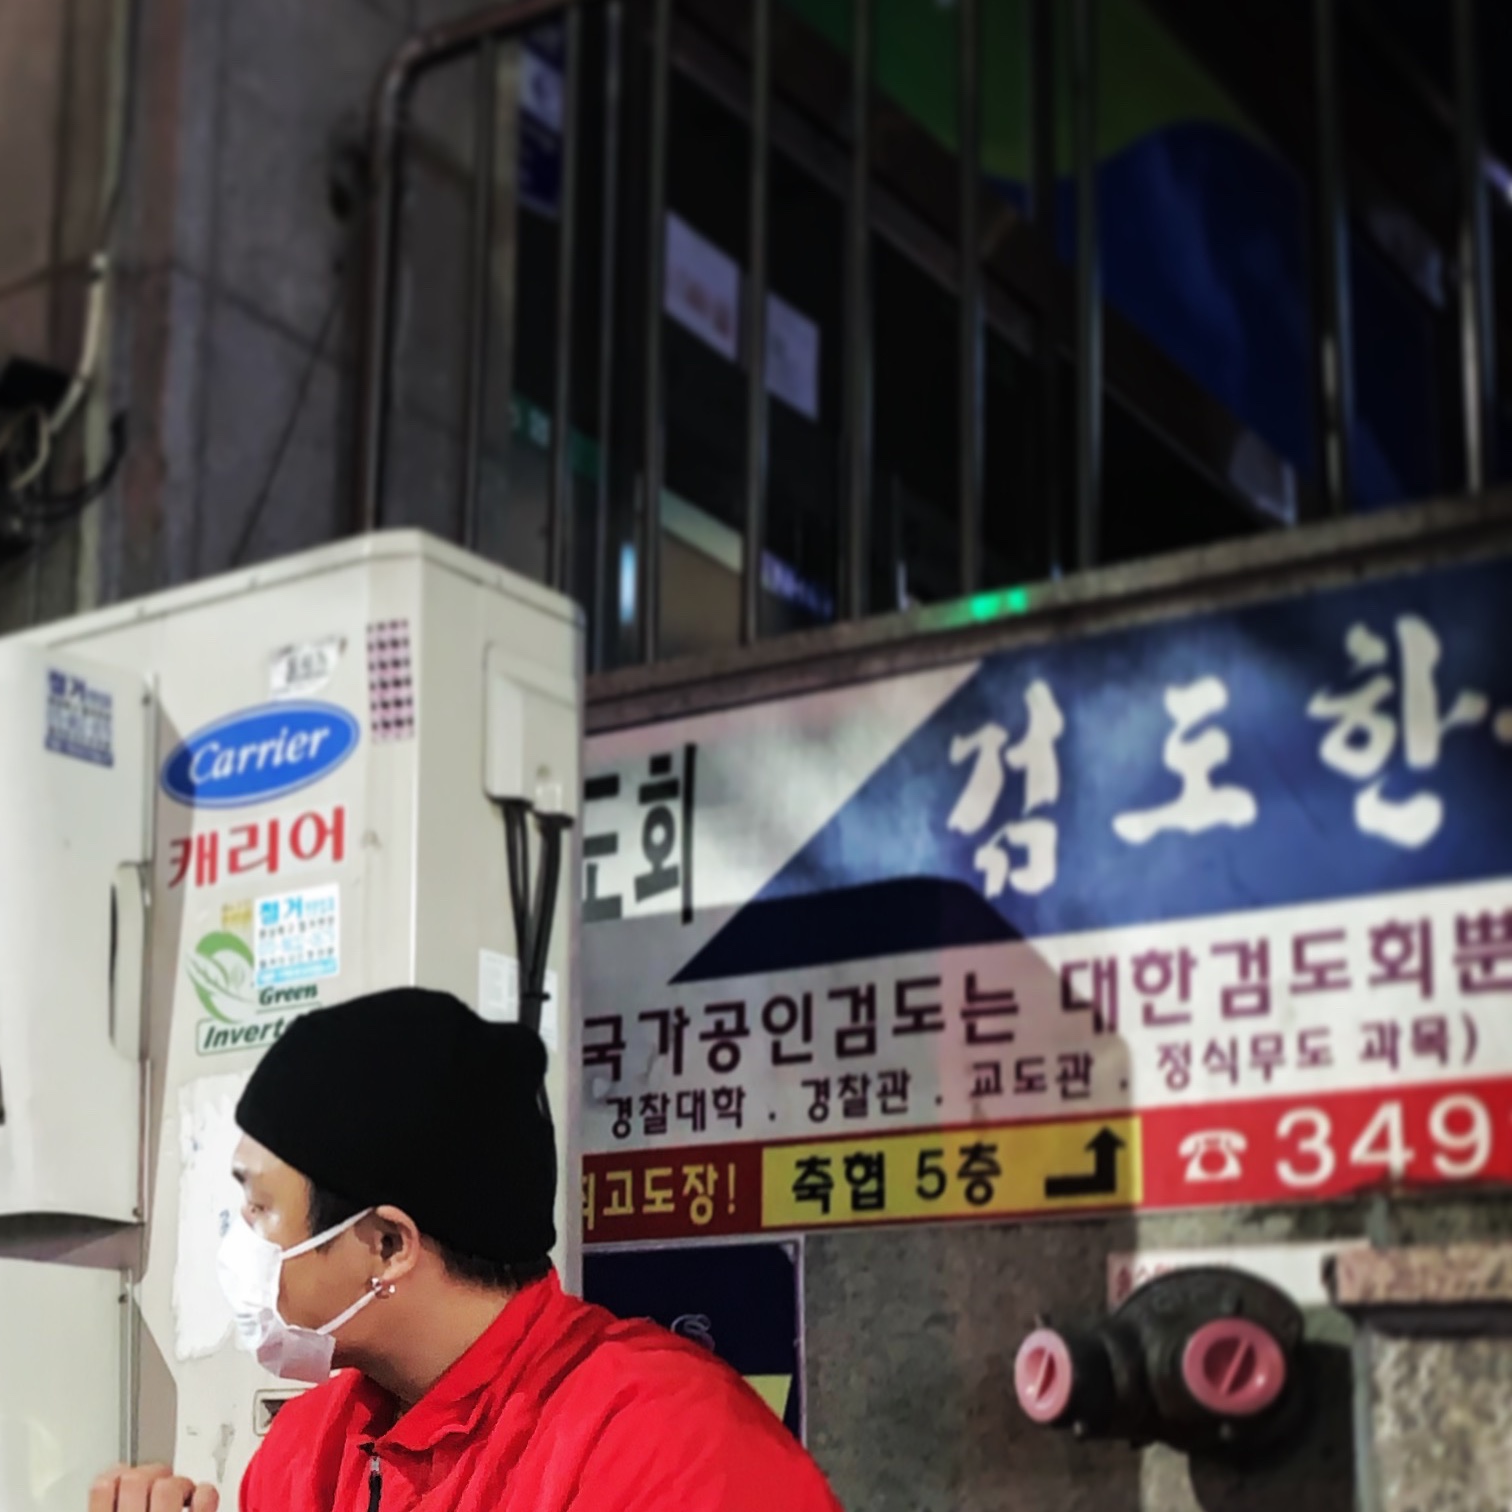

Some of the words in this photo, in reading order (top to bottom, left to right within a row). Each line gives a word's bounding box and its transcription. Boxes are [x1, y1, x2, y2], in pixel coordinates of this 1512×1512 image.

[190, 726, 331, 785] Carrier
[168, 805, 345, 889] 캐리어
[258, 983, 318, 1006] Green
[583, 972, 1020, 1081] 국가공인검도는
[203, 1016, 288, 1050] Invert
[606, 1086, 747, 1139] 경찰대학
[800, 1068, 912, 1123] 경찰관
[970, 1051, 1094, 1100] 교도관
[1156, 1026, 1334, 1092] 정식무도
[791, 1150, 887, 1215] 축협
[915, 1141, 1002, 1207] 5층
